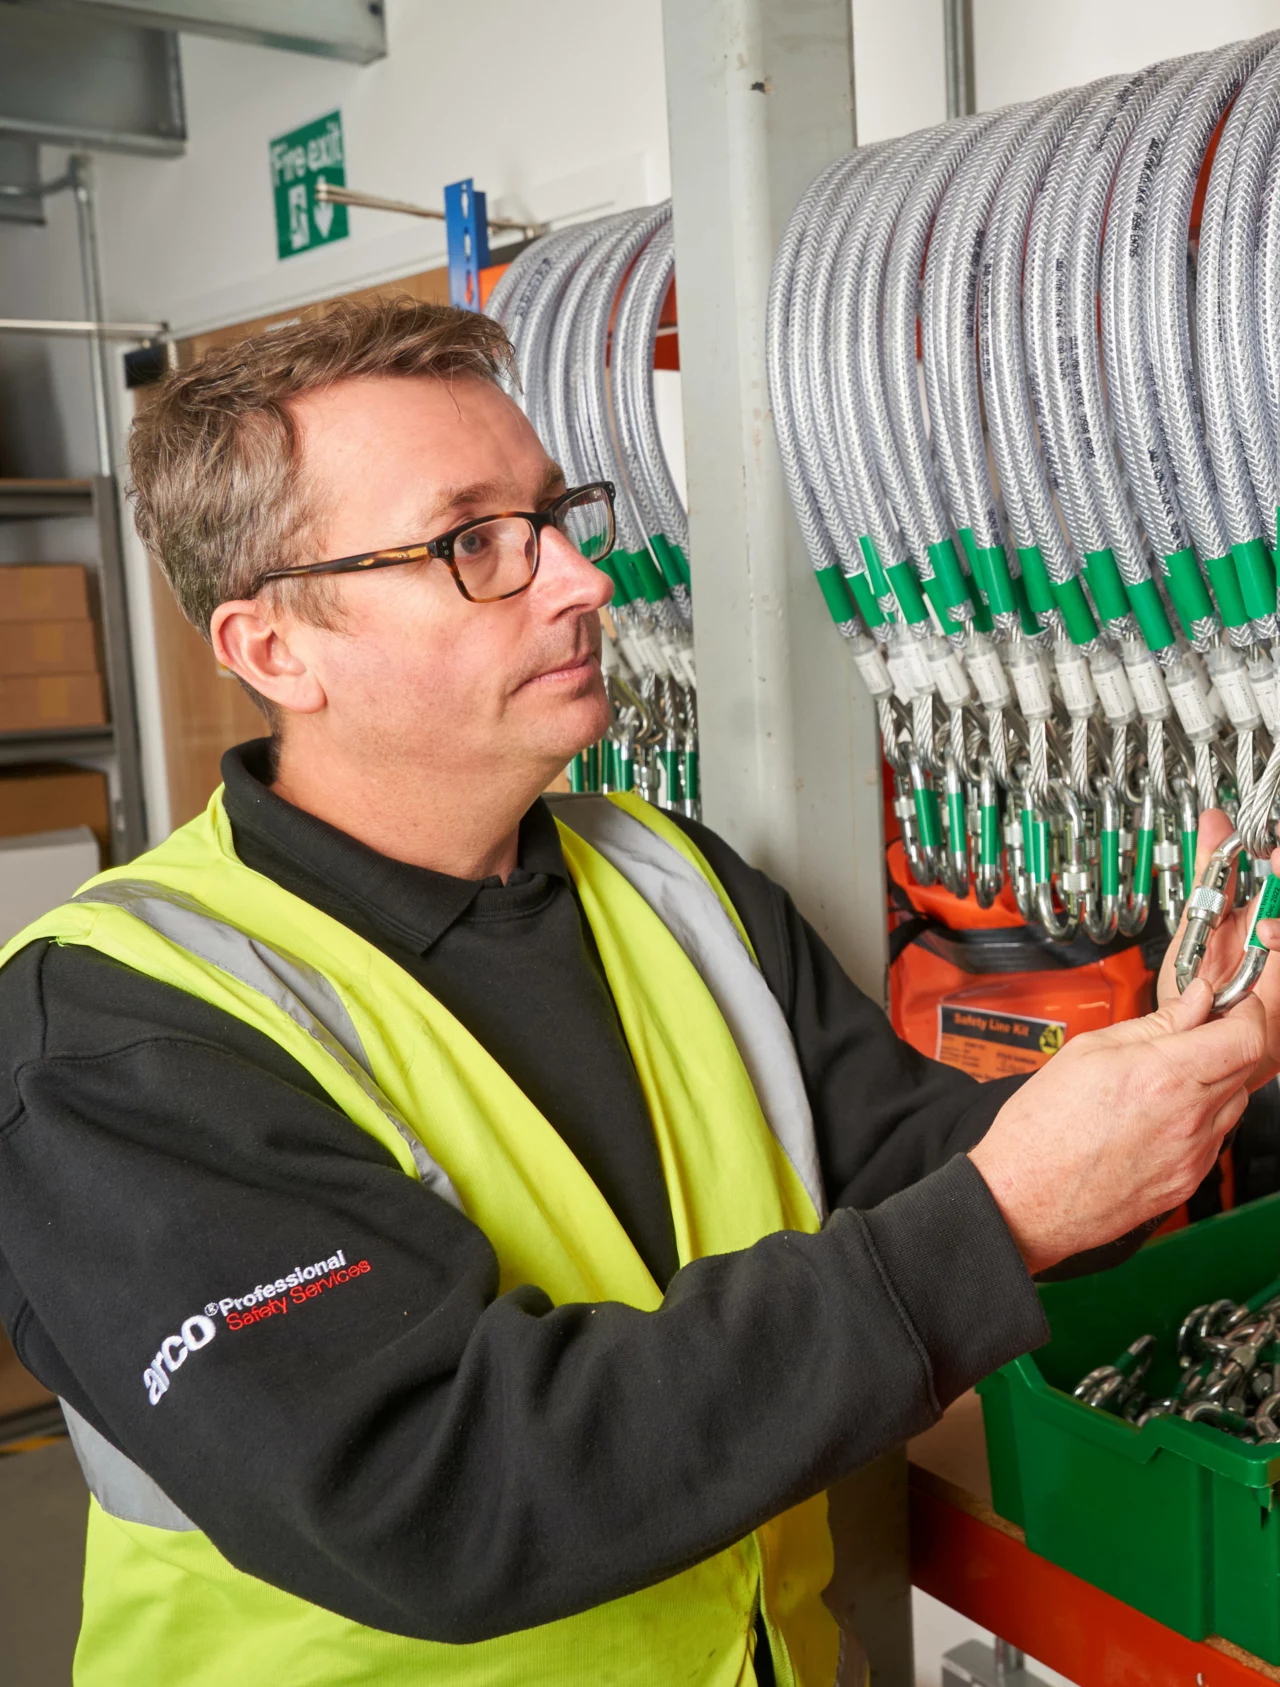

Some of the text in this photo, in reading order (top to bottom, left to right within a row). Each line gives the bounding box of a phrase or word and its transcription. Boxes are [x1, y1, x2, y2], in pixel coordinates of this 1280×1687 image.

[271, 122, 344, 187] Fire exit
[1261, 878, 1275, 905] between
[1270, 887, 1280, 902] 2022
[953, 1012, 1030, 1037] Safety Line Kit
[219, 1249, 347, 1317] Professional
[226, 1258, 372, 1332] Safety Services
